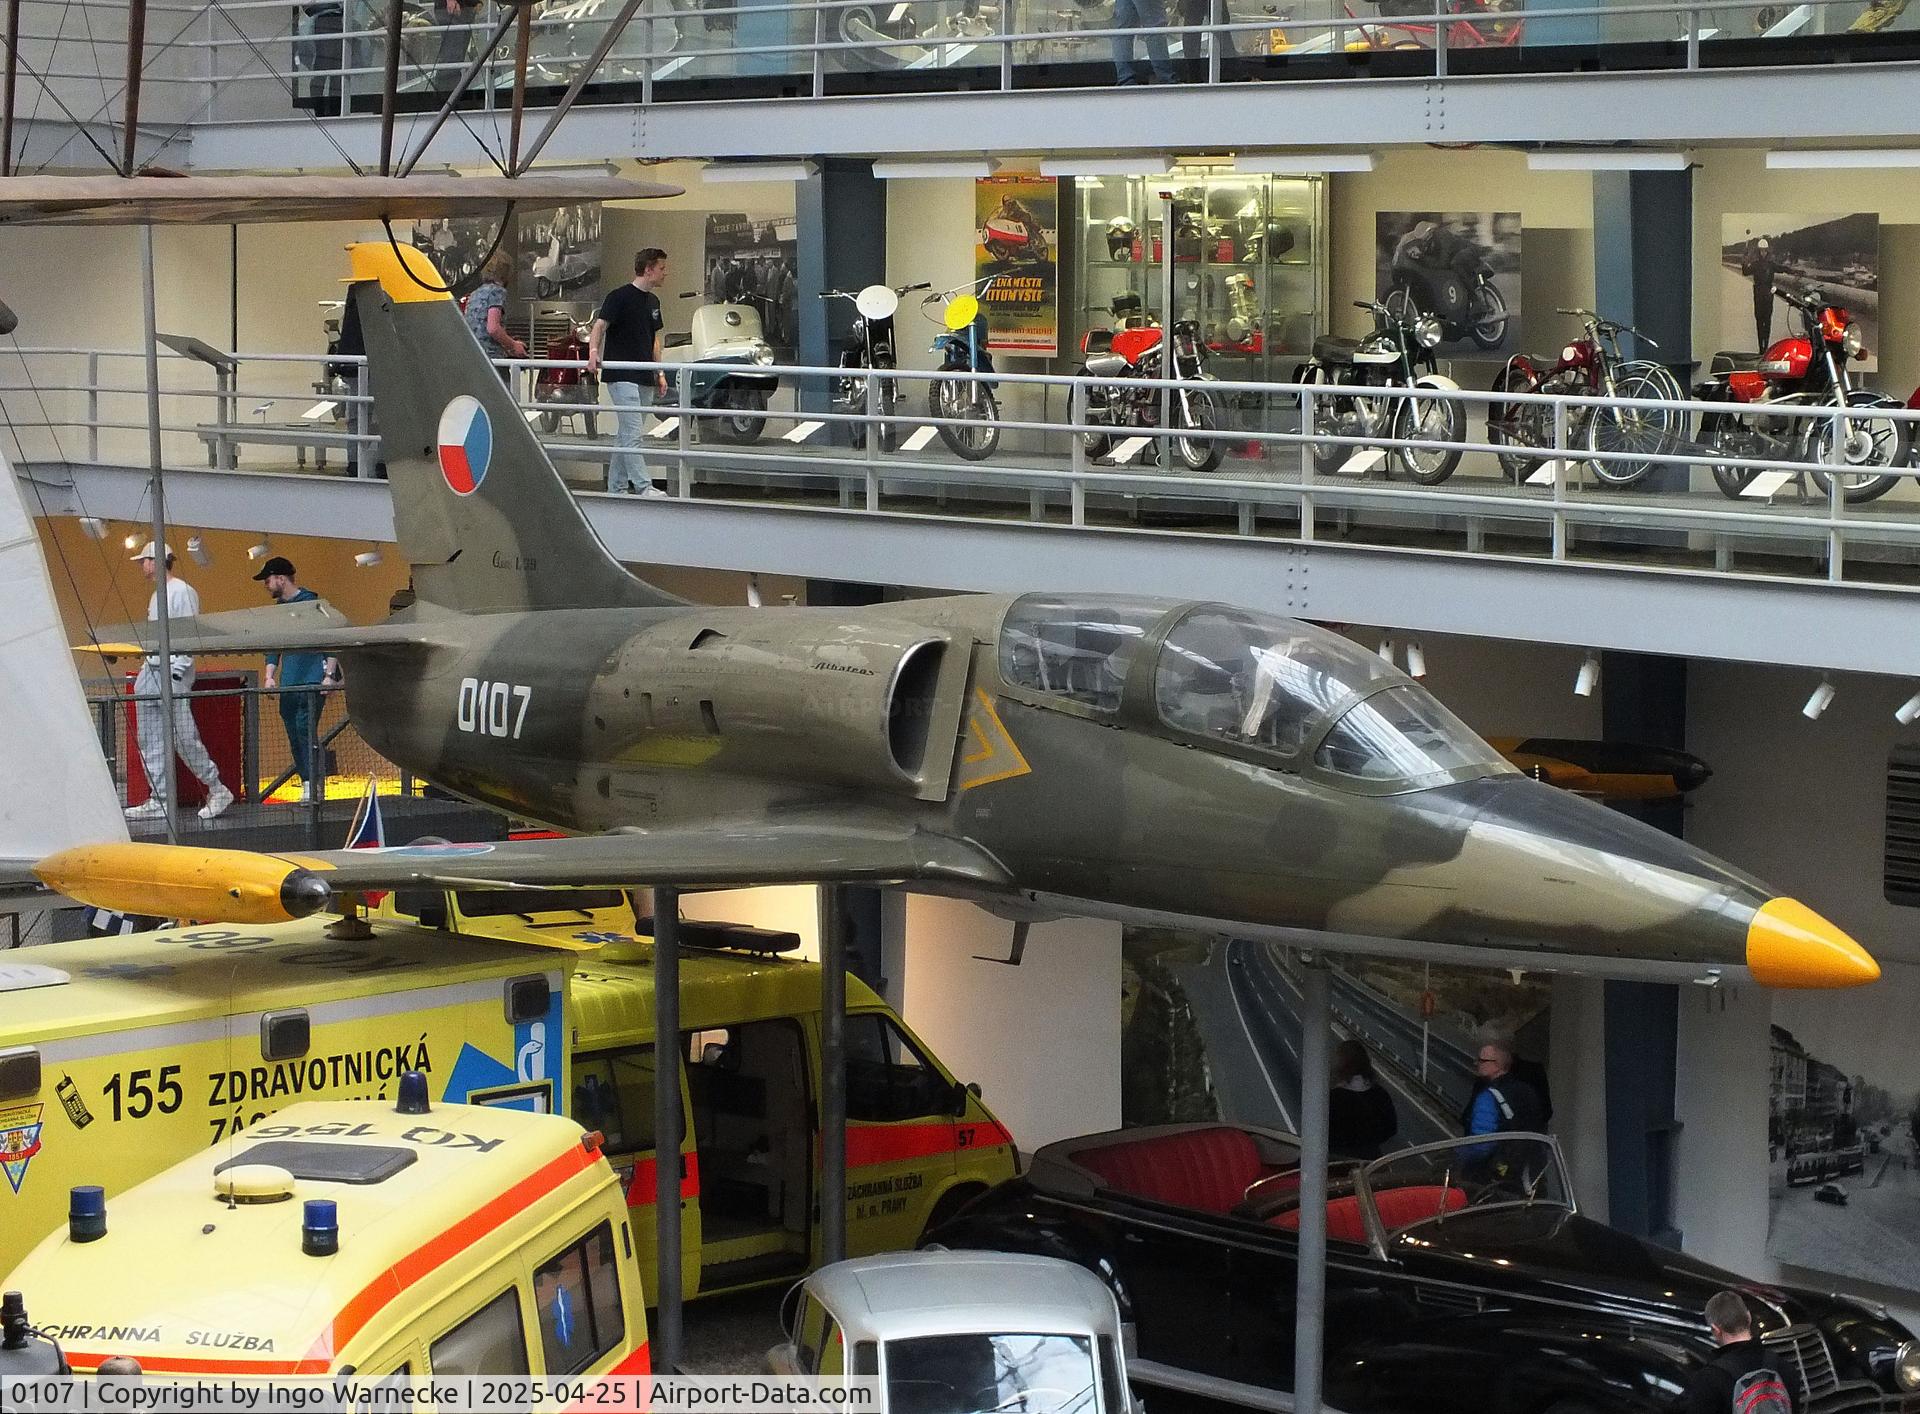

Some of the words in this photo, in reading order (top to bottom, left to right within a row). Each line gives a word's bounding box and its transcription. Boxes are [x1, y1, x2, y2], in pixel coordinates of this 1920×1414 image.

[1448, 285, 1456, 304] 9
[458, 677, 532, 739] 0107
[208, 1032, 432, 1107] ZDRAVOTNICKÁ
[103, 1065, 184, 1122] 155
[246, 1122, 379, 1139] 156
[958, 1128, 976, 1147] 57
[894, 1173, 923, 1192] SLUŽBA
[881, 1197, 907, 1216] PRAHY
[27, 1321, 163, 1342] ÁCHRANNÁ
[185, 1330, 275, 1353] SLUŽBA
